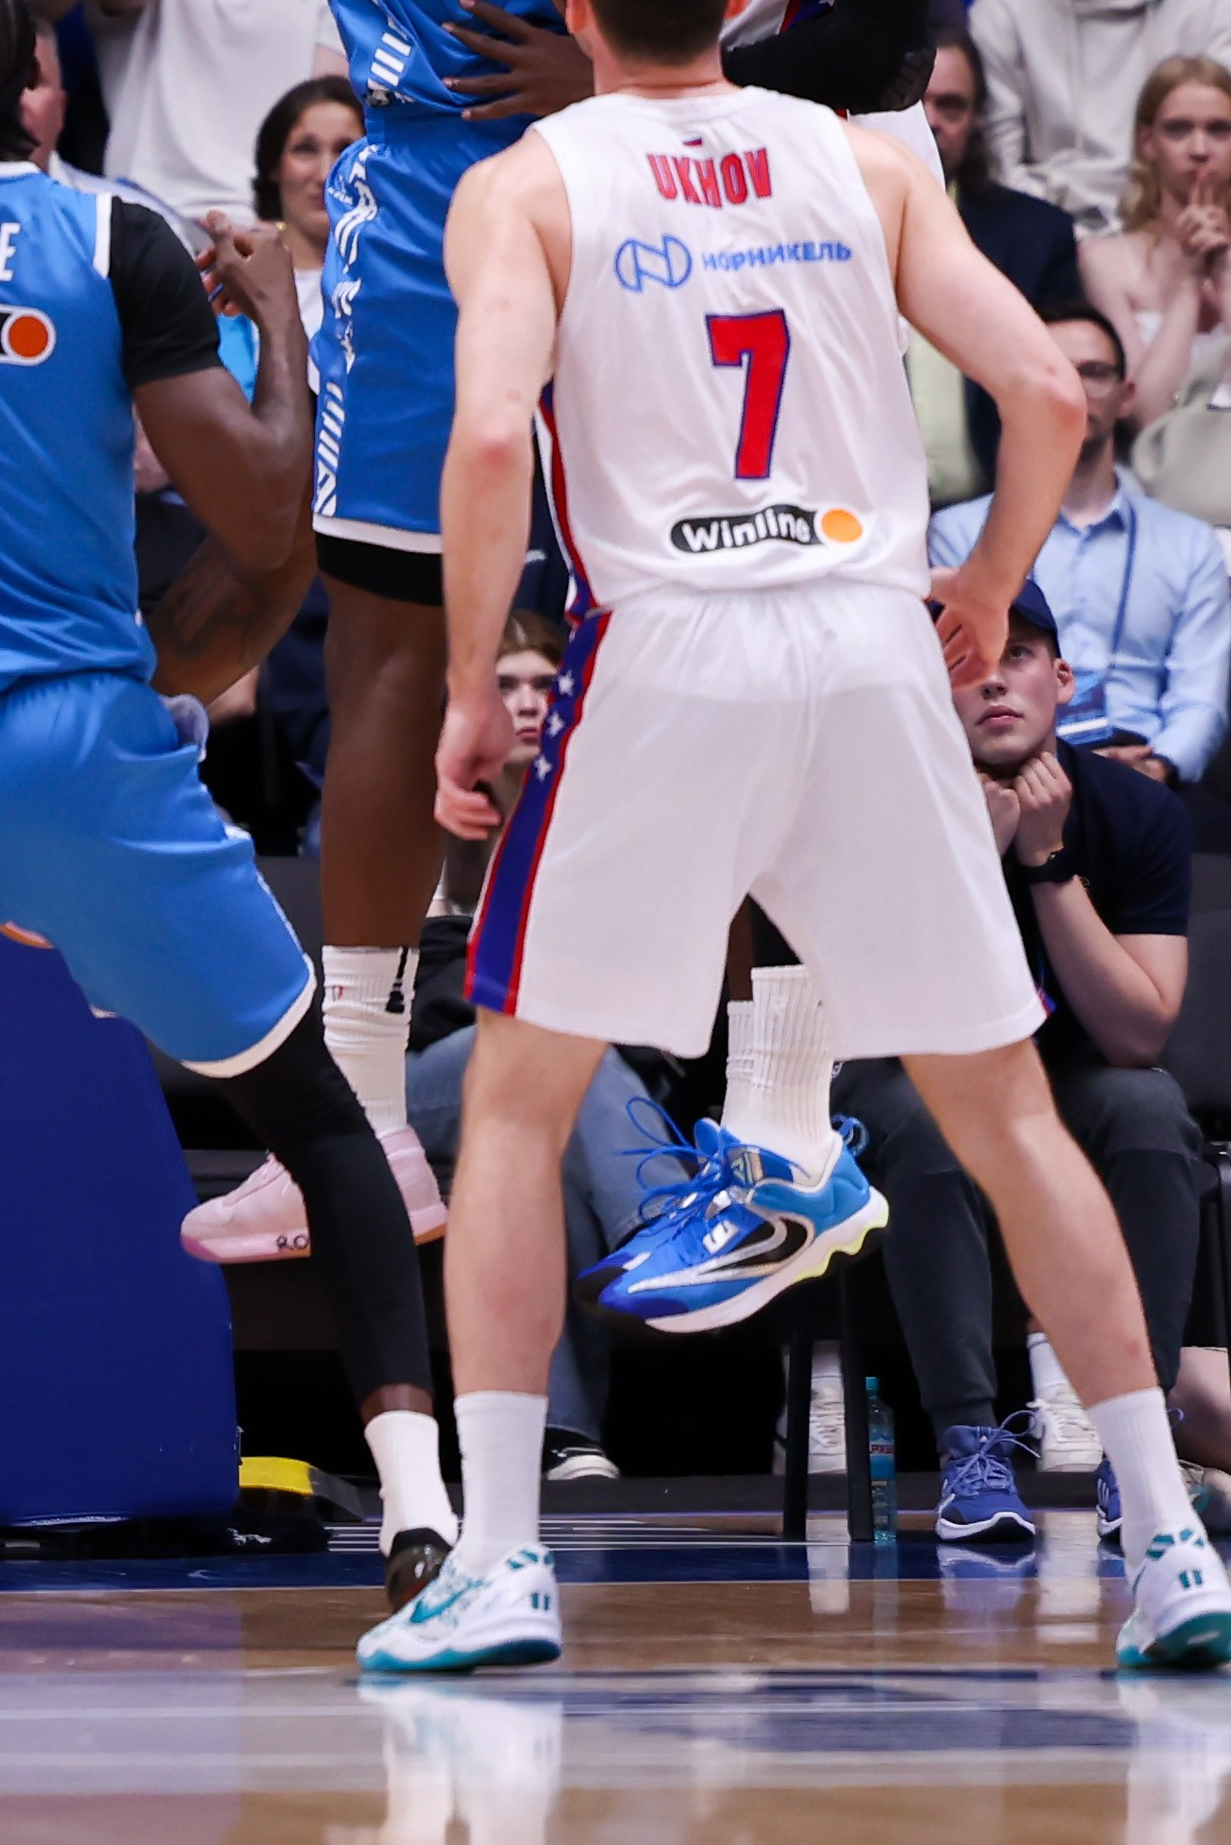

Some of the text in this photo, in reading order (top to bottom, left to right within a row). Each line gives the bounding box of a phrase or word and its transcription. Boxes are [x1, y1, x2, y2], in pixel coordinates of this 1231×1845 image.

[646, 146, 773, 211] UKHOV
[704, 308, 791, 480] 7
[681, 508, 811, 553] Winline
